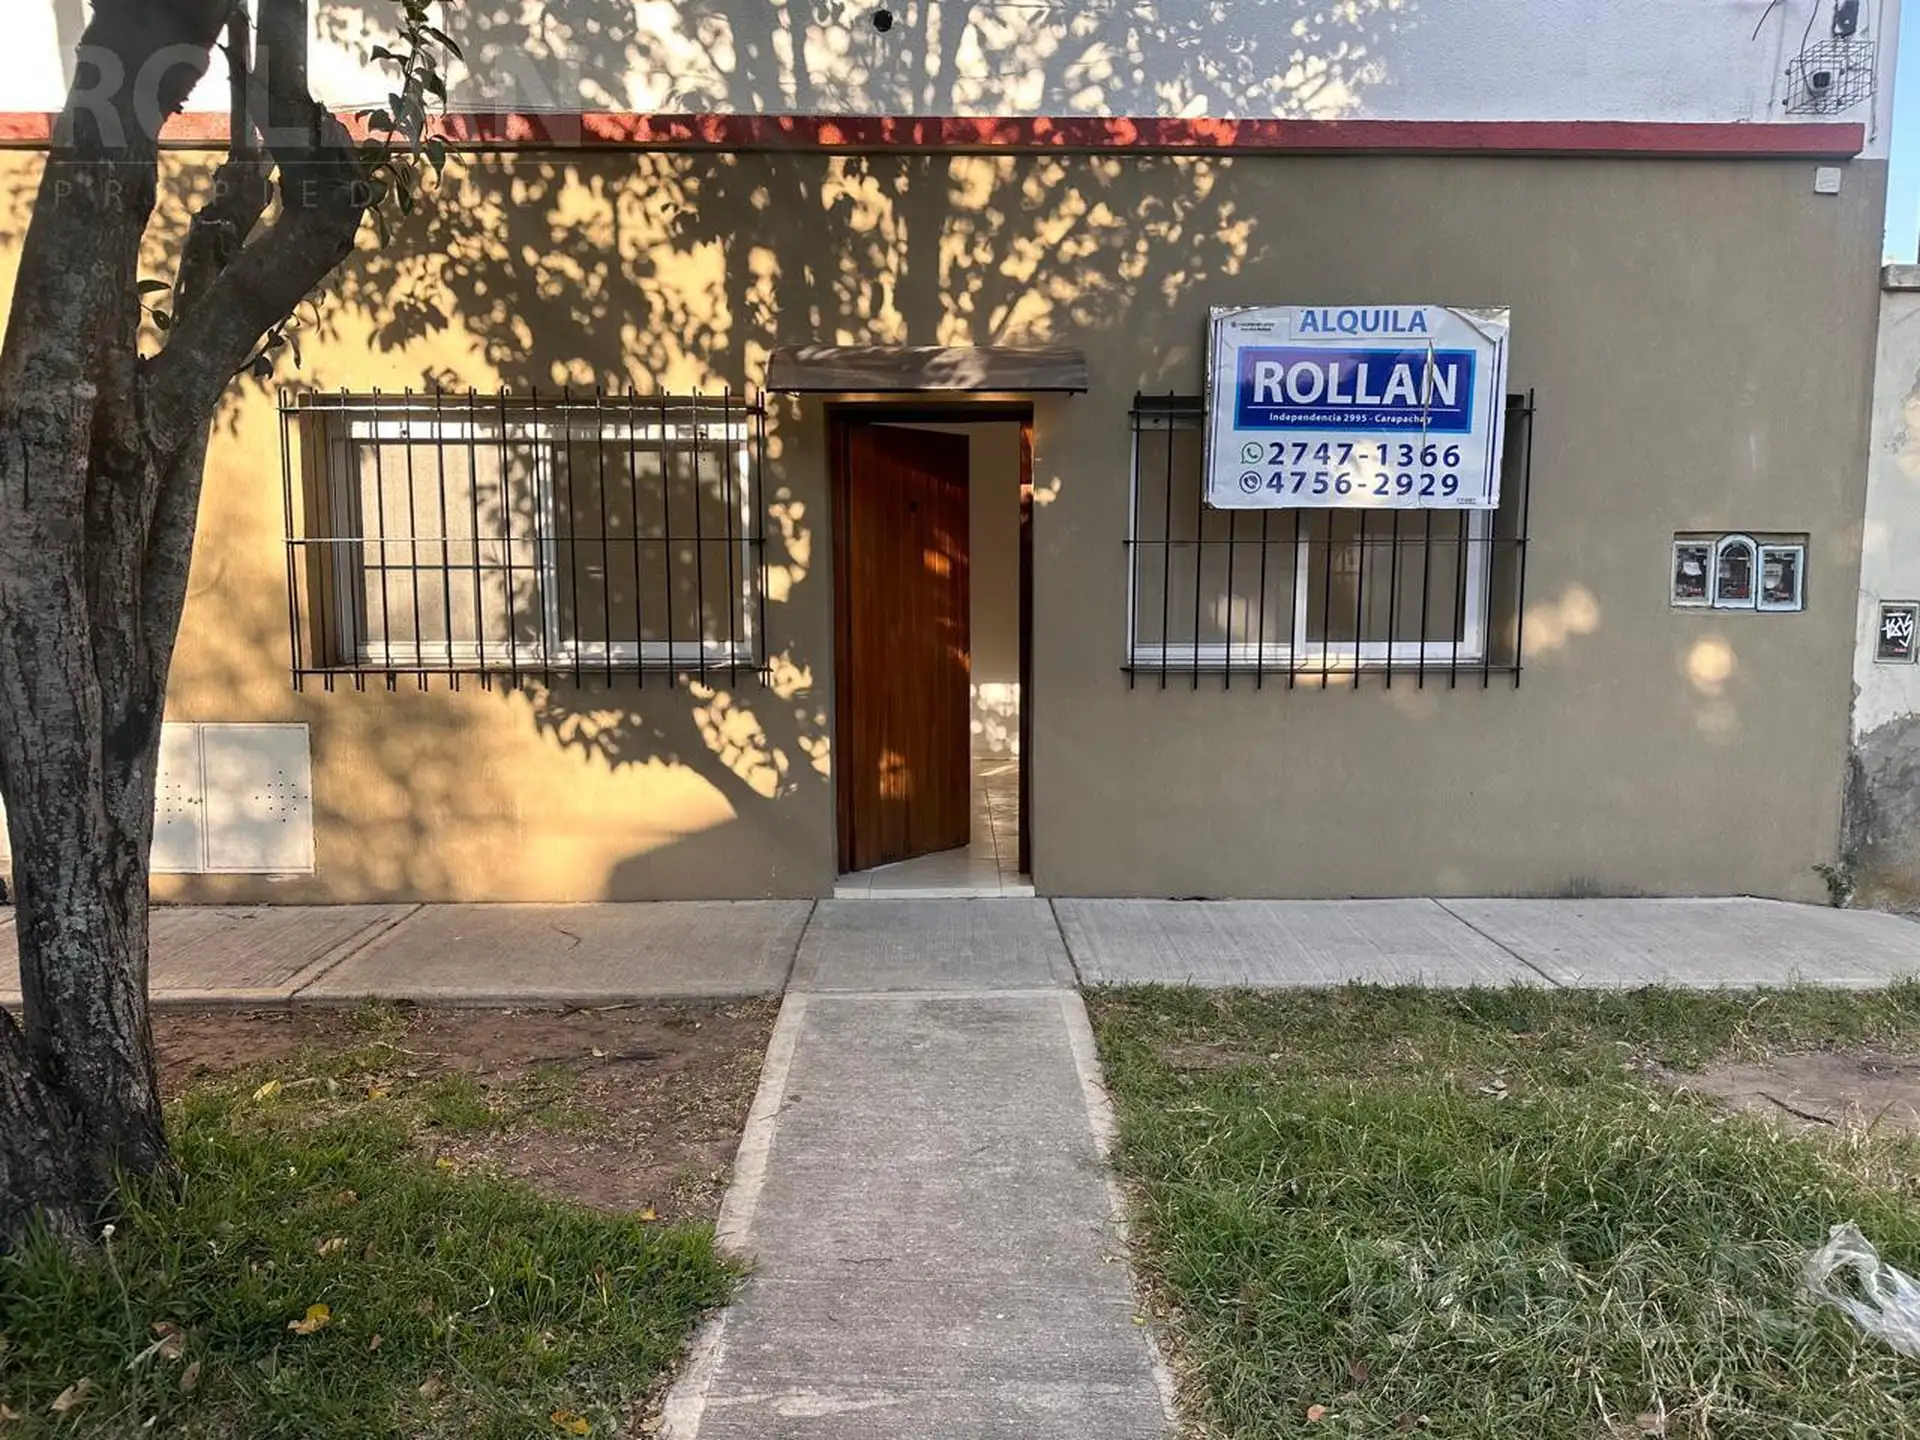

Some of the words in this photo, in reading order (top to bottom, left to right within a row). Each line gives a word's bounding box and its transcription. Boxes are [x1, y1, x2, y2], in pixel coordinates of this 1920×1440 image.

[1299, 309, 1428, 334] ALQUILA
[1253, 361, 1457, 406] ROLLAN
[1269, 412, 1342, 424] Independencia
[1344, 413, 1368, 423] 2995
[1268, 442, 1461, 468] 2747-1366
[1266, 471, 1459, 497] 4756-2929
